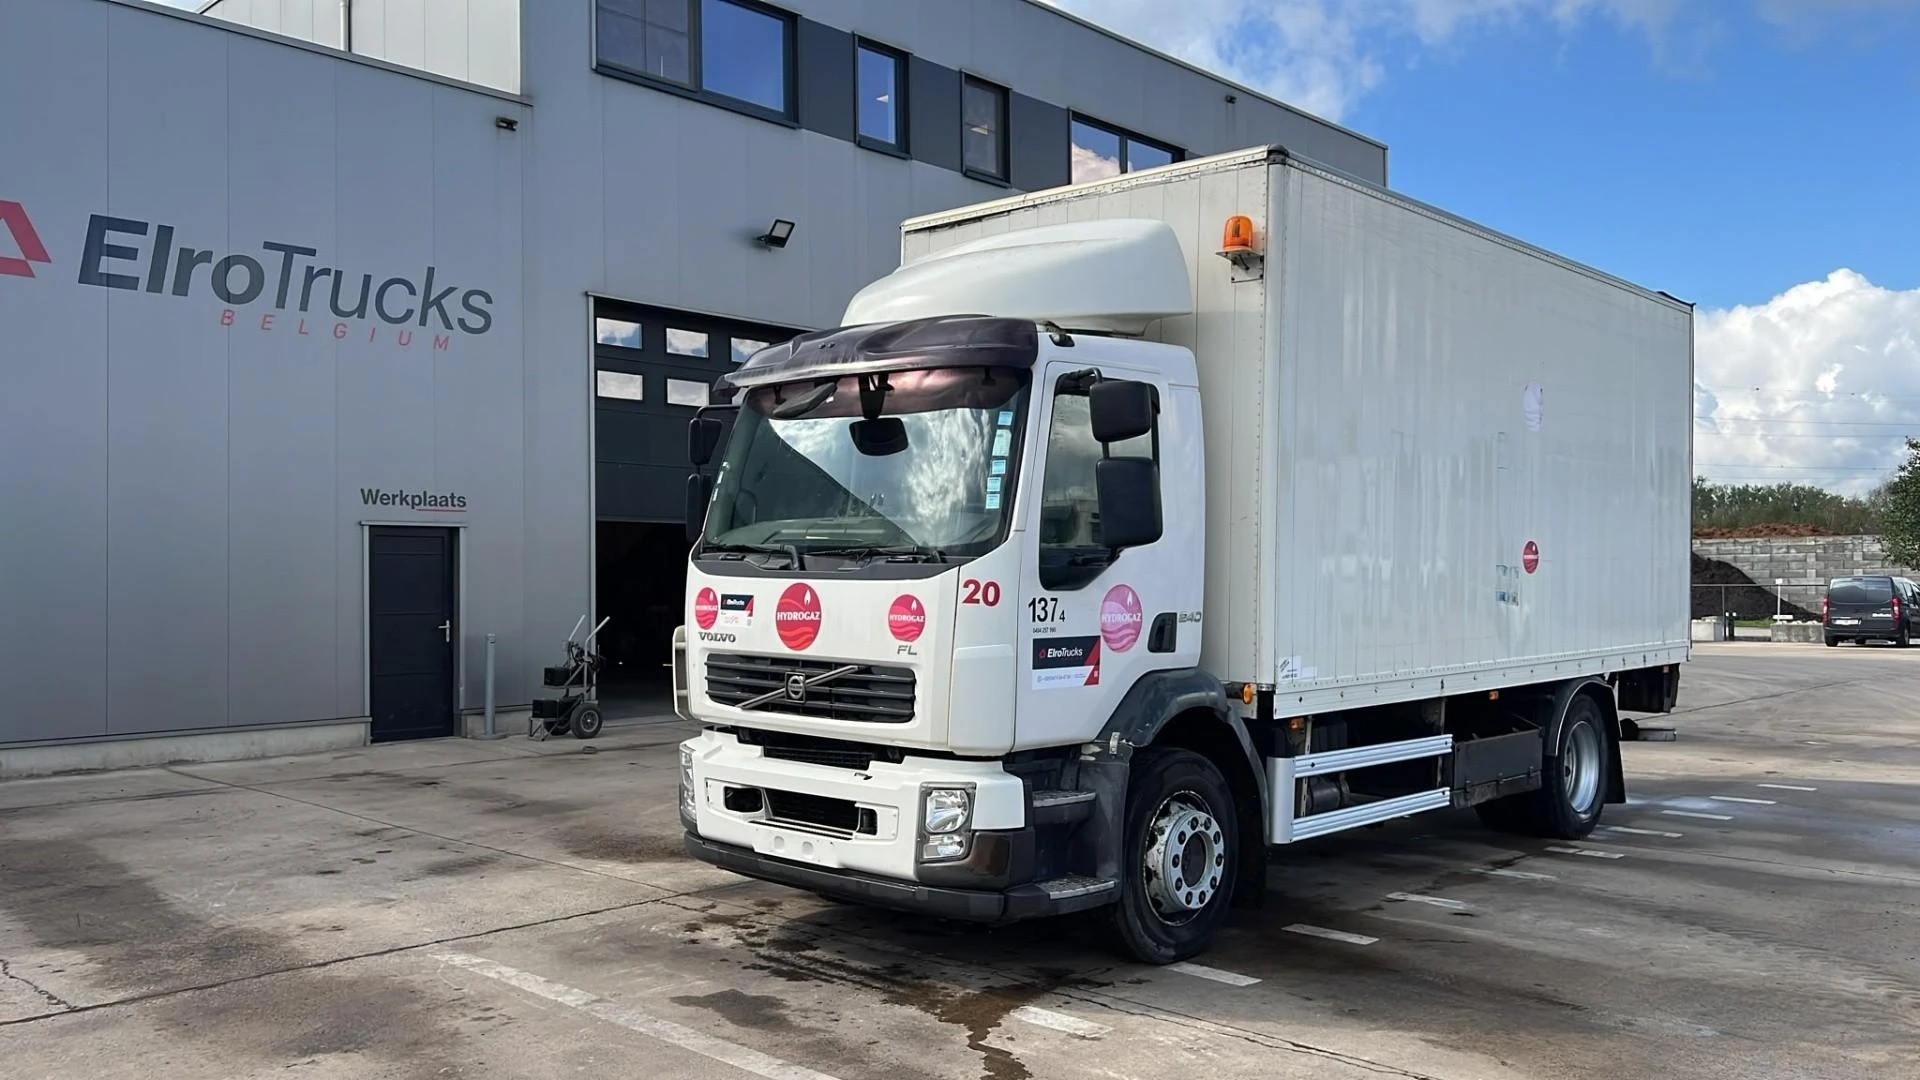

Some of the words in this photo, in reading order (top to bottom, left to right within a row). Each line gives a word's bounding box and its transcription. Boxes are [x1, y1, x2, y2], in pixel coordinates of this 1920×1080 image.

[78, 213, 494, 335] ElroTrucks
[220, 309, 451, 351] BELGIUM
[360, 487, 467, 509] Werkplaats
[962, 579, 1001, 607] 20
[776, 610, 821, 622] HYDROGAZ
[889, 614, 925, 623] HYDROGAZ
[1101, 612, 1142, 624] HYDROGAZ
[698, 631, 737, 643] VOLVO
[897, 645, 918, 656] FL
[1047, 647, 1084, 658] ElroTrucks
